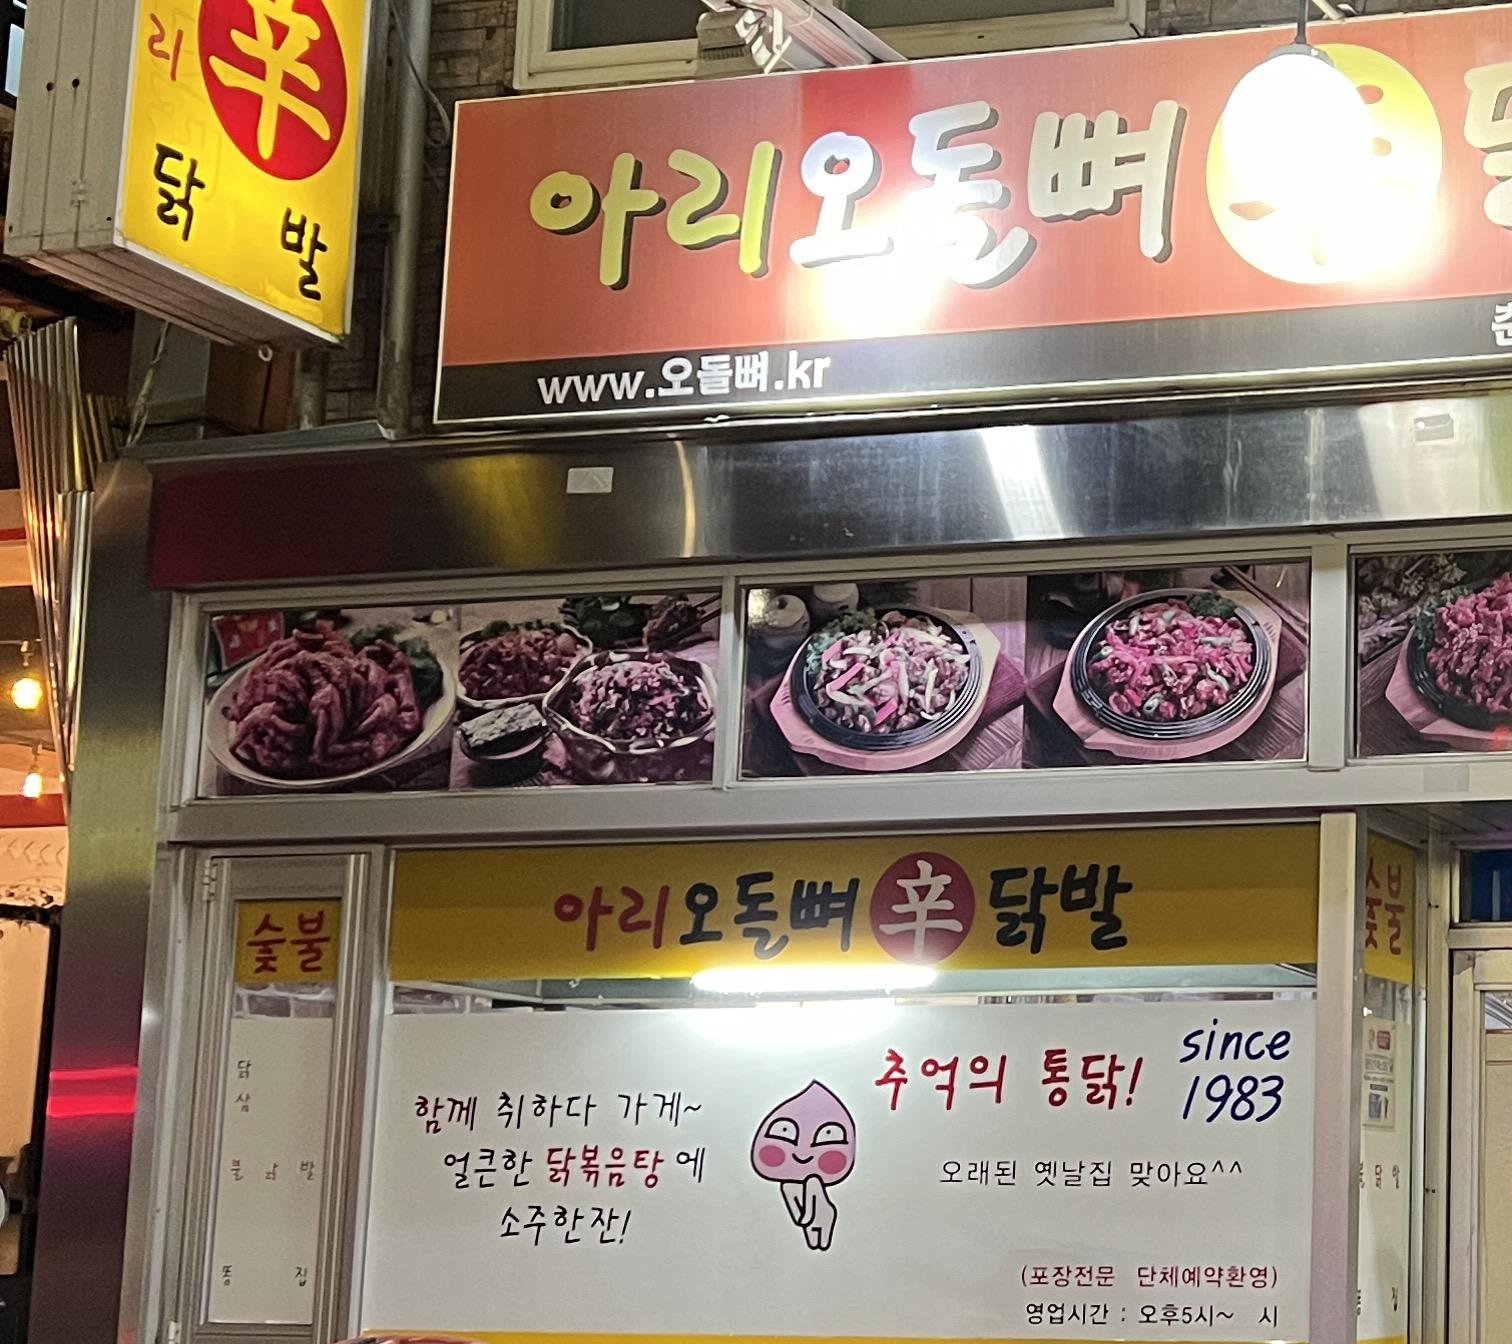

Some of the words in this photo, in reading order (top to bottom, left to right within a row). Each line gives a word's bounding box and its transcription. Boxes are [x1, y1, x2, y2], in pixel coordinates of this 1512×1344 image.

[537, 352, 831, 404] www.오돌뼈.kr
[879, 859, 964, 956] 辛
[989, 863, 1133, 955] 닭발
[1179, 1017, 1292, 1064] since
[874, 1047, 1007, 1111] 추억의
[1041, 1047, 1144, 1109] 통닭!
[1182, 1074, 1285, 1123] 1983
[414, 1094, 477, 1134] 함께
[498, 1091, 597, 1130] 취하다
[444, 1148, 533, 1189] 얼큰한
[676, 1147, 706, 1183] 에
[939, 1159, 1018, 1188] 오래된
[1033, 1159, 1113, 1188] 옛날집
[500, 1205, 631, 1246] 소주한잔!
[1021, 1264, 1115, 1288] (포장전문
[1137, 1264, 1279, 1289] 단체예약환영)
[1026, 1303, 1109, 1326] 영업시간
